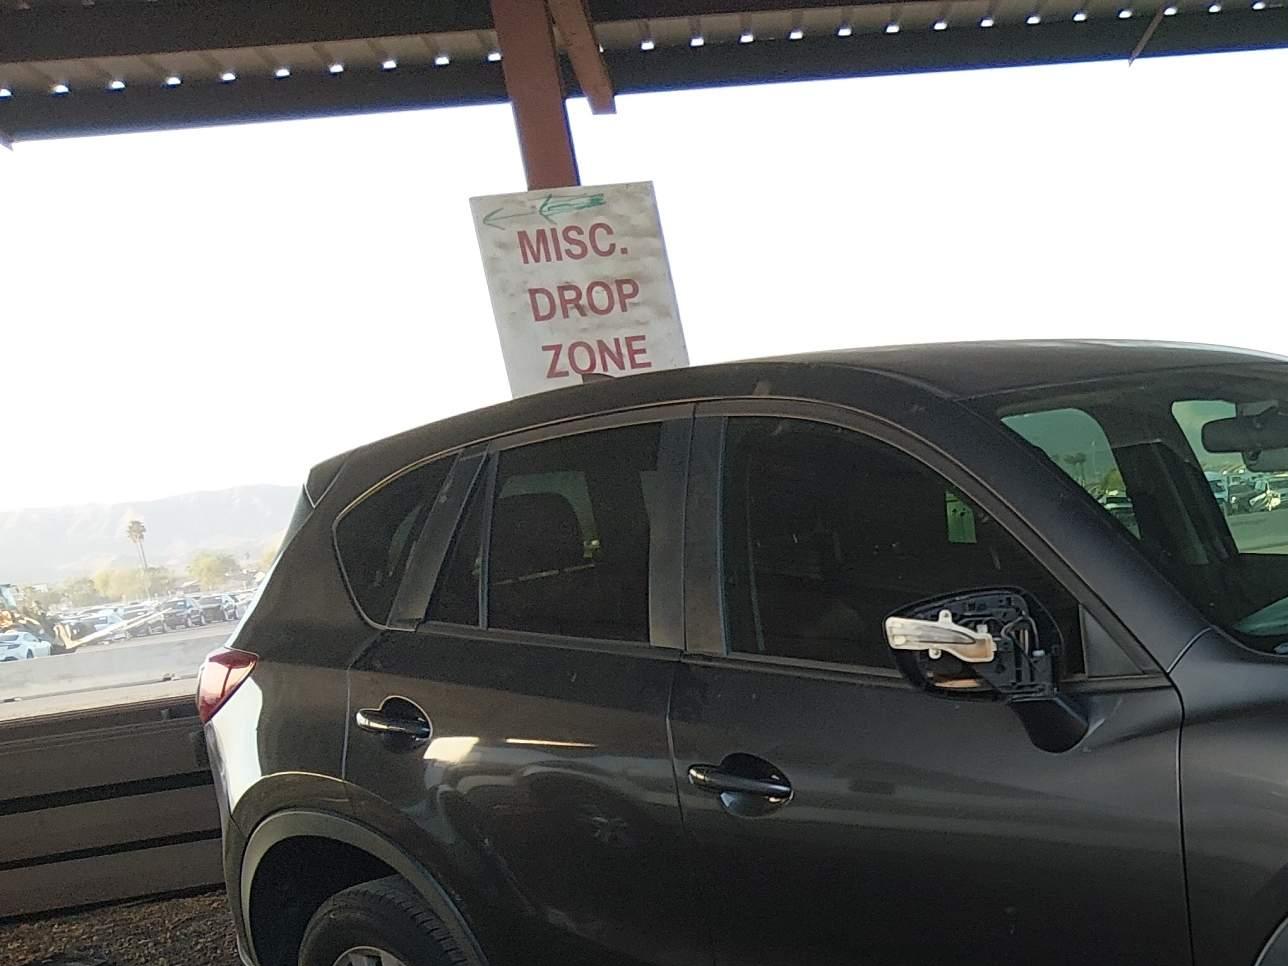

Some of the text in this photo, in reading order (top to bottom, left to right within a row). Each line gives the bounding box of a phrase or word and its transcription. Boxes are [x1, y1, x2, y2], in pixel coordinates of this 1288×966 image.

[517, 222, 629, 264] MISC.
[527, 278, 640, 321] DROP
[541, 335, 653, 379] ZONE
